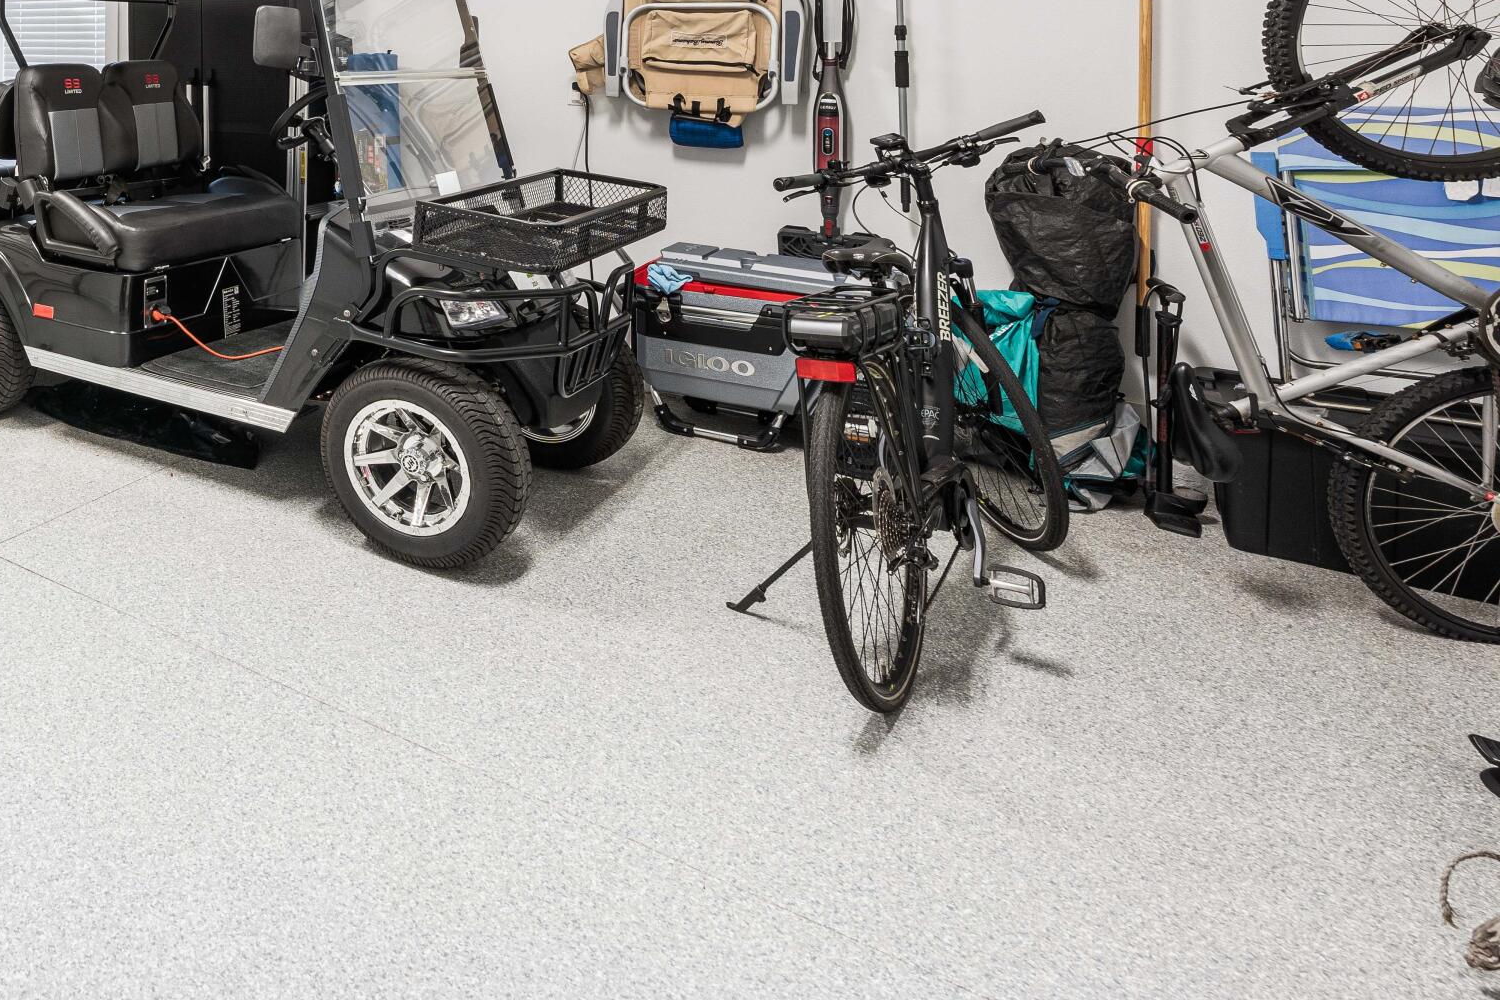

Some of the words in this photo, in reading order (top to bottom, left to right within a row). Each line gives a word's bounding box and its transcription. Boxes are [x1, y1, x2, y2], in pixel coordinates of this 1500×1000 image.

[937, 271, 951, 342] BREEZER
[664, 348, 756, 377] IGLOO
[920, 408, 940, 420] EPAC
